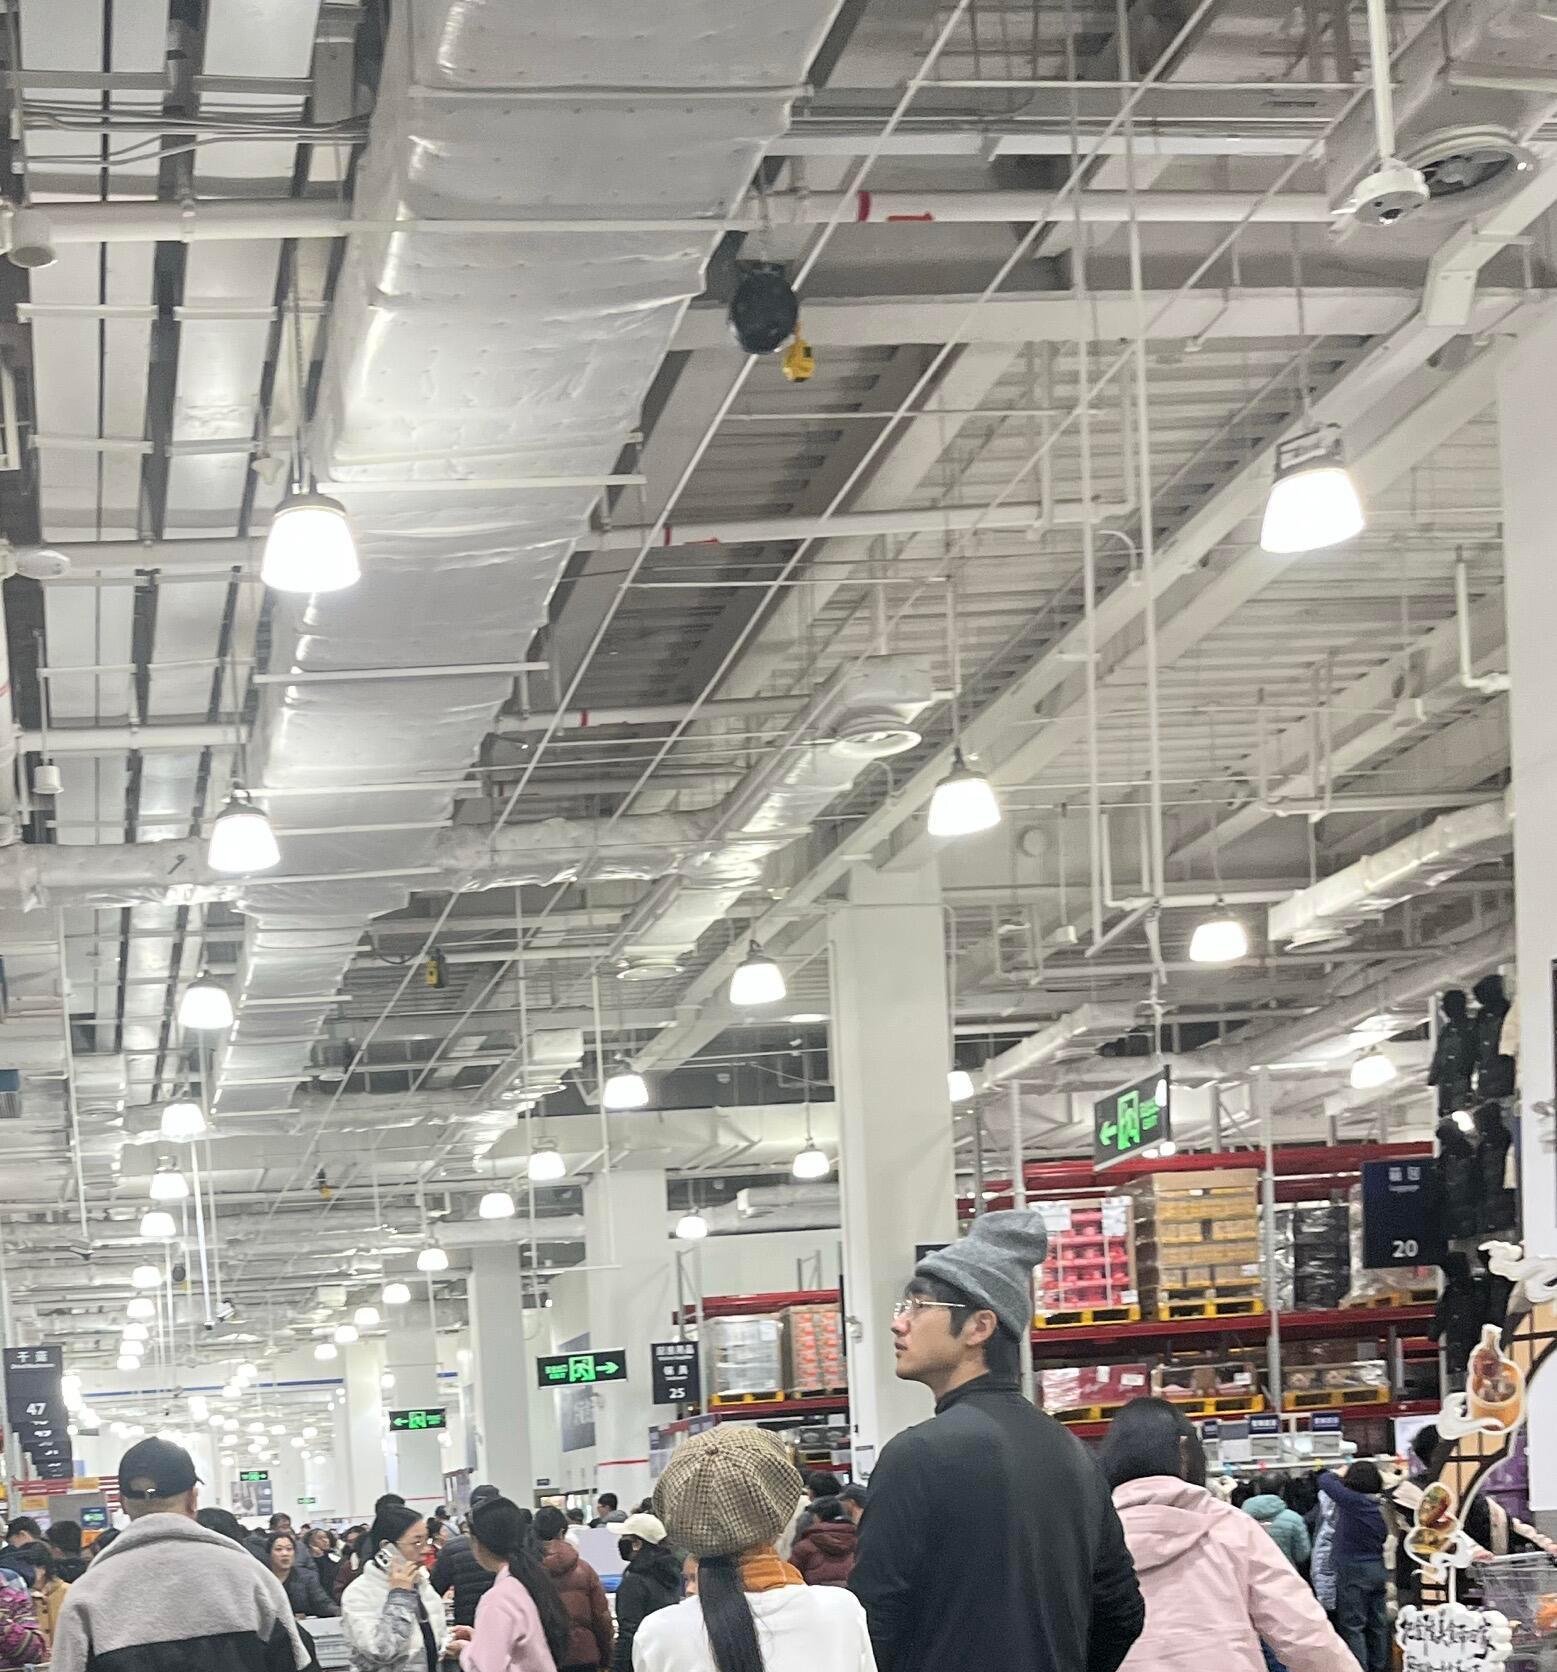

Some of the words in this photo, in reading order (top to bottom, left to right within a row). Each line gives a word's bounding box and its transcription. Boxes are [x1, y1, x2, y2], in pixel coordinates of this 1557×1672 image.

[1392, 1239, 1419, 1257] 20
[669, 1387, 686, 1399] 25
[26, 1402, 47, 1415] 47
